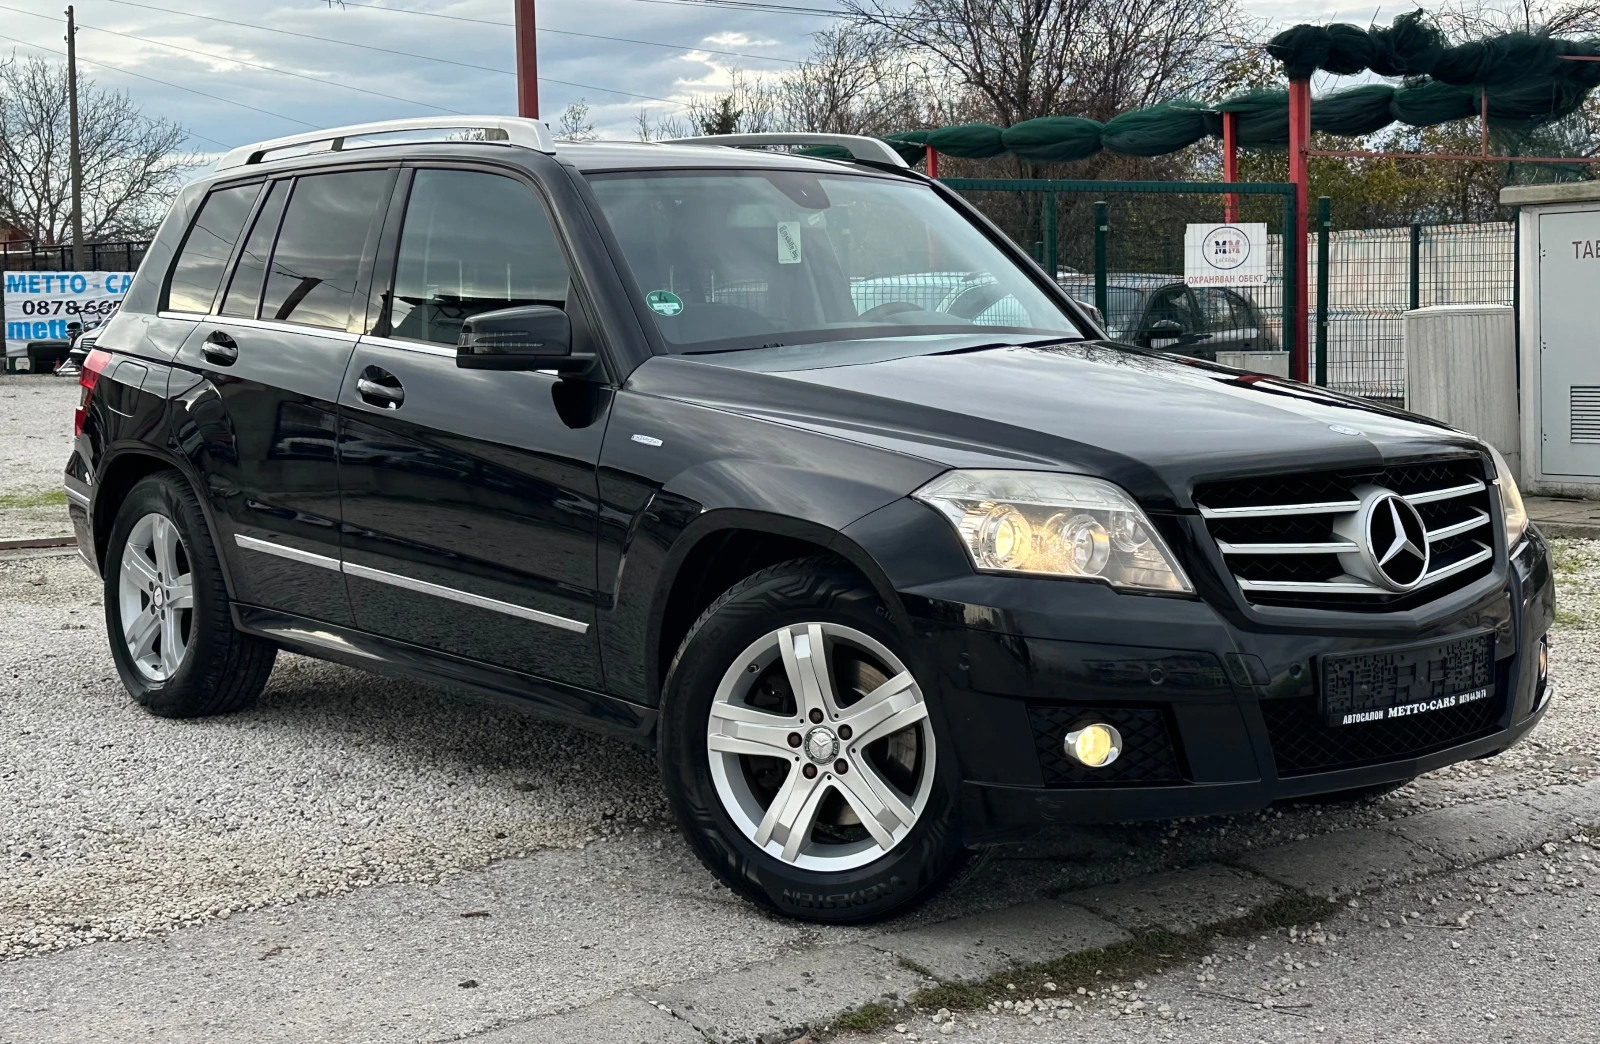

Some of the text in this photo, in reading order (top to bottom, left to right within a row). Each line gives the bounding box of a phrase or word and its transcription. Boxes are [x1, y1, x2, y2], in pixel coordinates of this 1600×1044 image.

[6, 274, 87, 294] METTO
[1188, 274, 1264, 284] ОХРАНЯВАН ОБЕКТ
[22, 300, 77, 315] 0878
[7, 320, 68, 340] mett
[1342, 709, 1384, 725] АВТОСАЛОН
[1387, 696, 1456, 719] METTO-CARS
